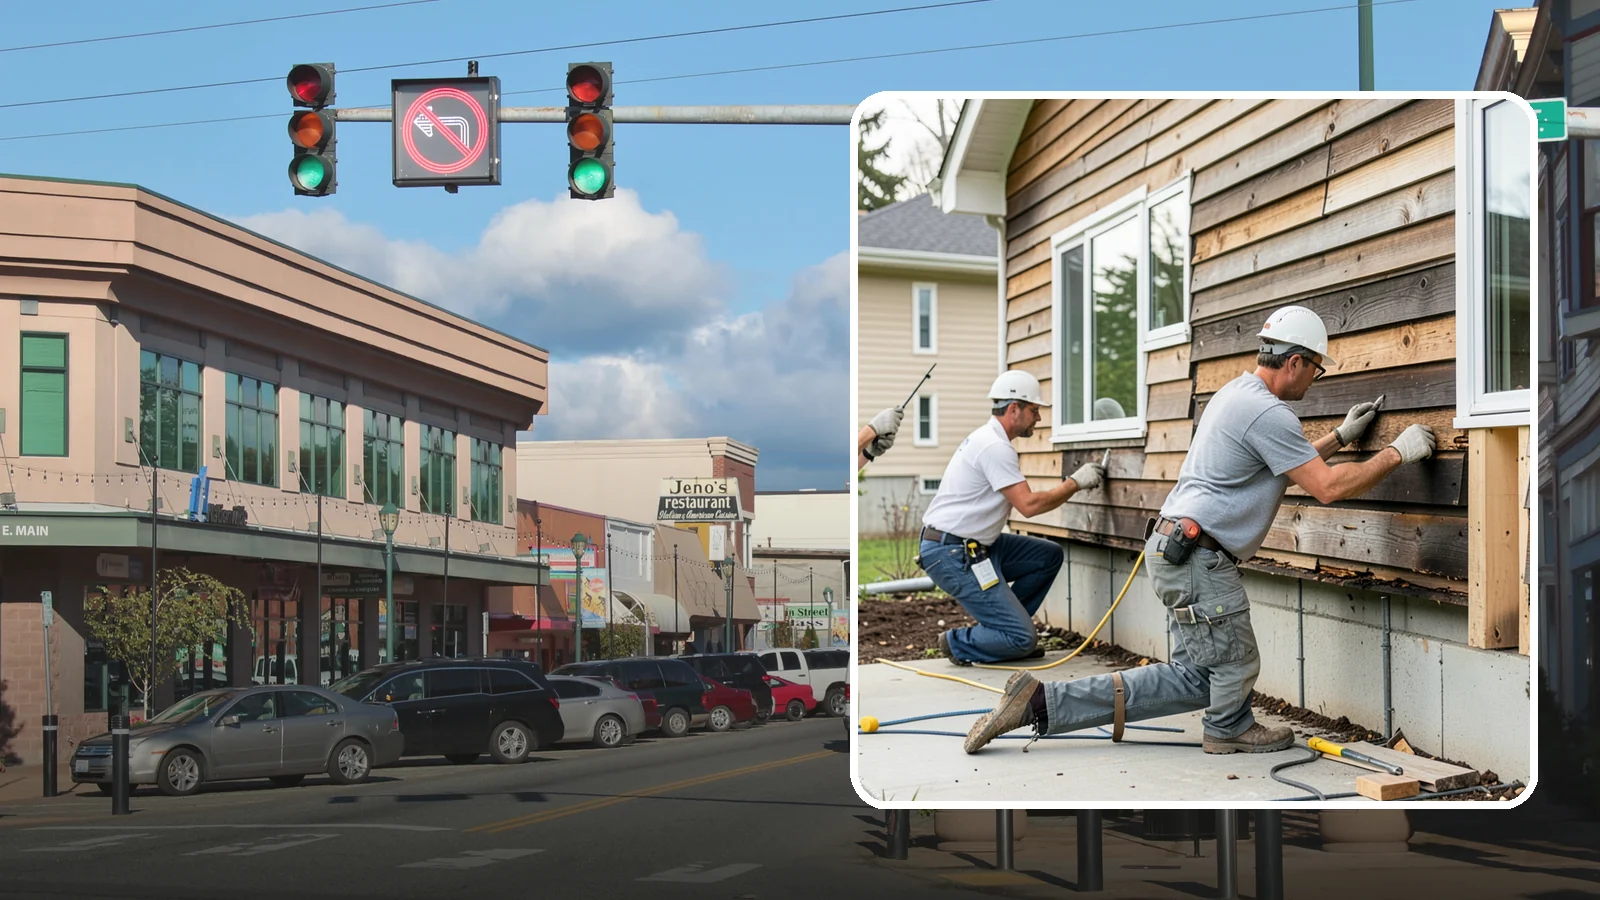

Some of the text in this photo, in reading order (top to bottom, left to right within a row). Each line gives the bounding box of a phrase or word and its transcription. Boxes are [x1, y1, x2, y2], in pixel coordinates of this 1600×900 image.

[669, 480, 727, 494] Jeno's
[665, 496, 731, 509] restaurant
[658, 510, 681, 519] Italian
[686, 510, 714, 519] American
[715, 509, 737, 519] Cuisine
[2, 525, 49, 536] E. MAIN
[797, 607, 828, 617] Street
